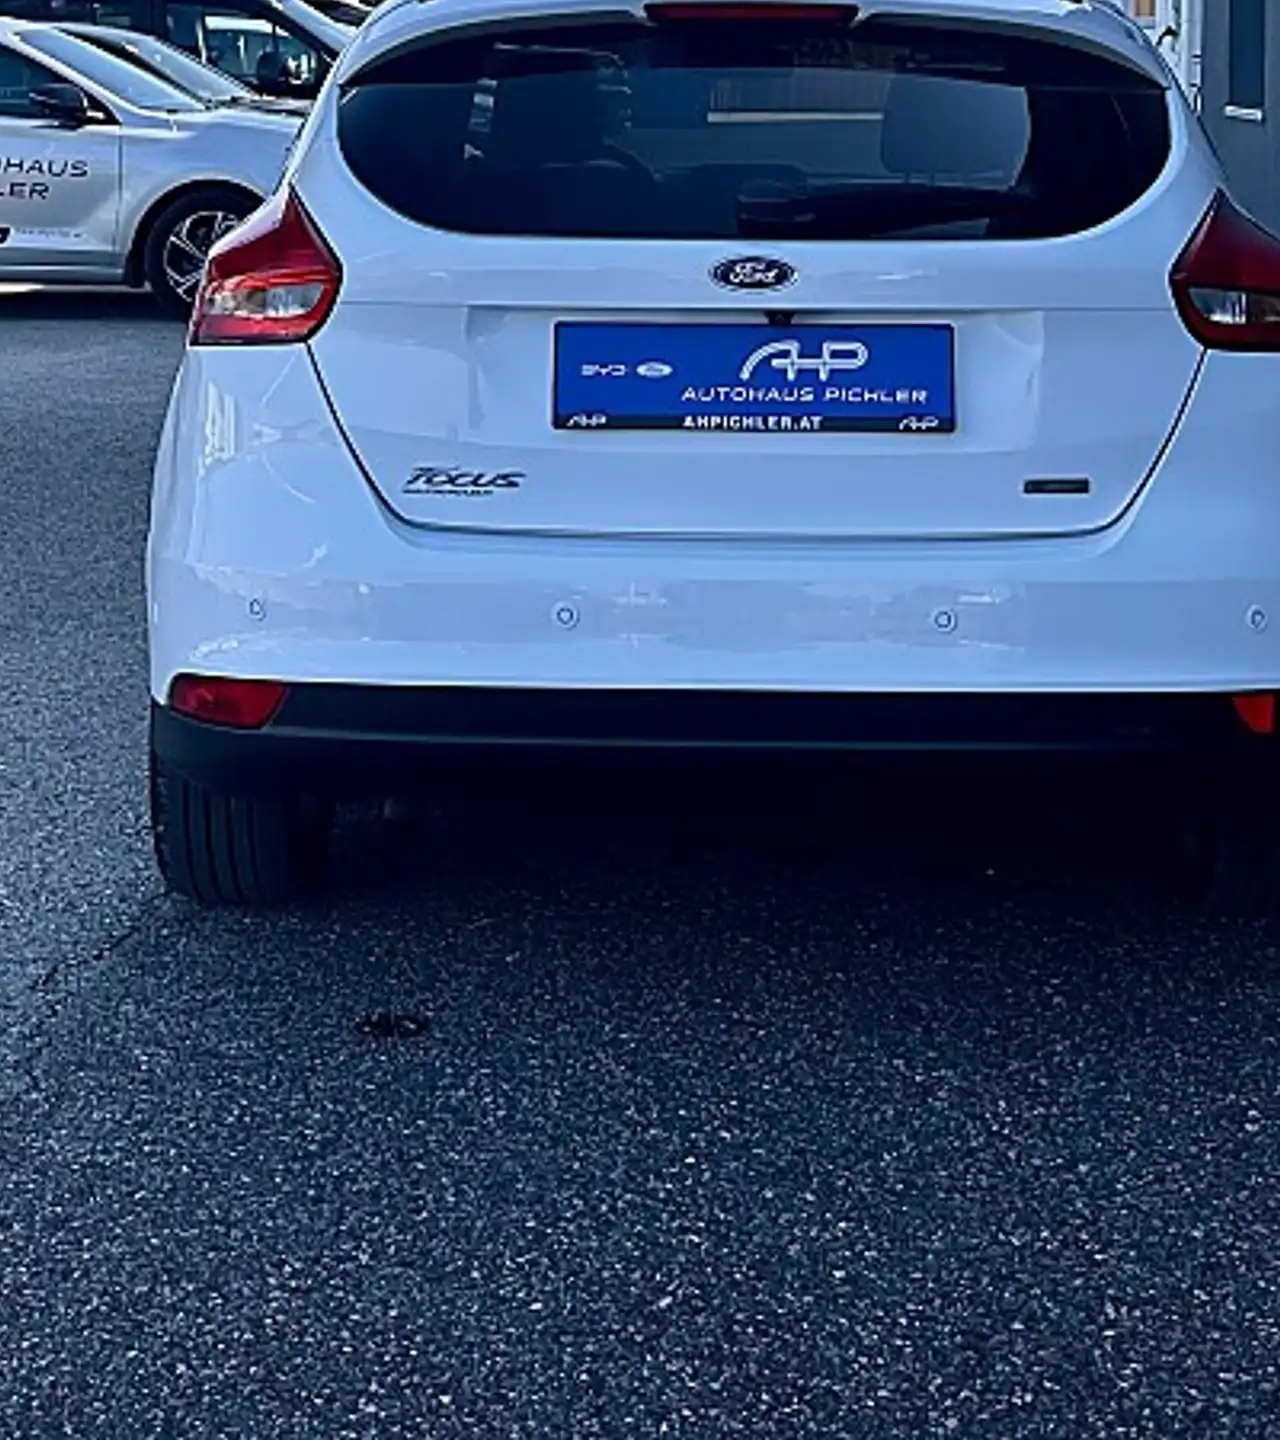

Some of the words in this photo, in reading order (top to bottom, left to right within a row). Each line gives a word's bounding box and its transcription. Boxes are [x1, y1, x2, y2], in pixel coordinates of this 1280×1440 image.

[680, 386, 815, 402] AUTOHAUS
[823, 386, 929, 405] PICHLER
[682, 415, 824, 431] AHPICHLER.AT
